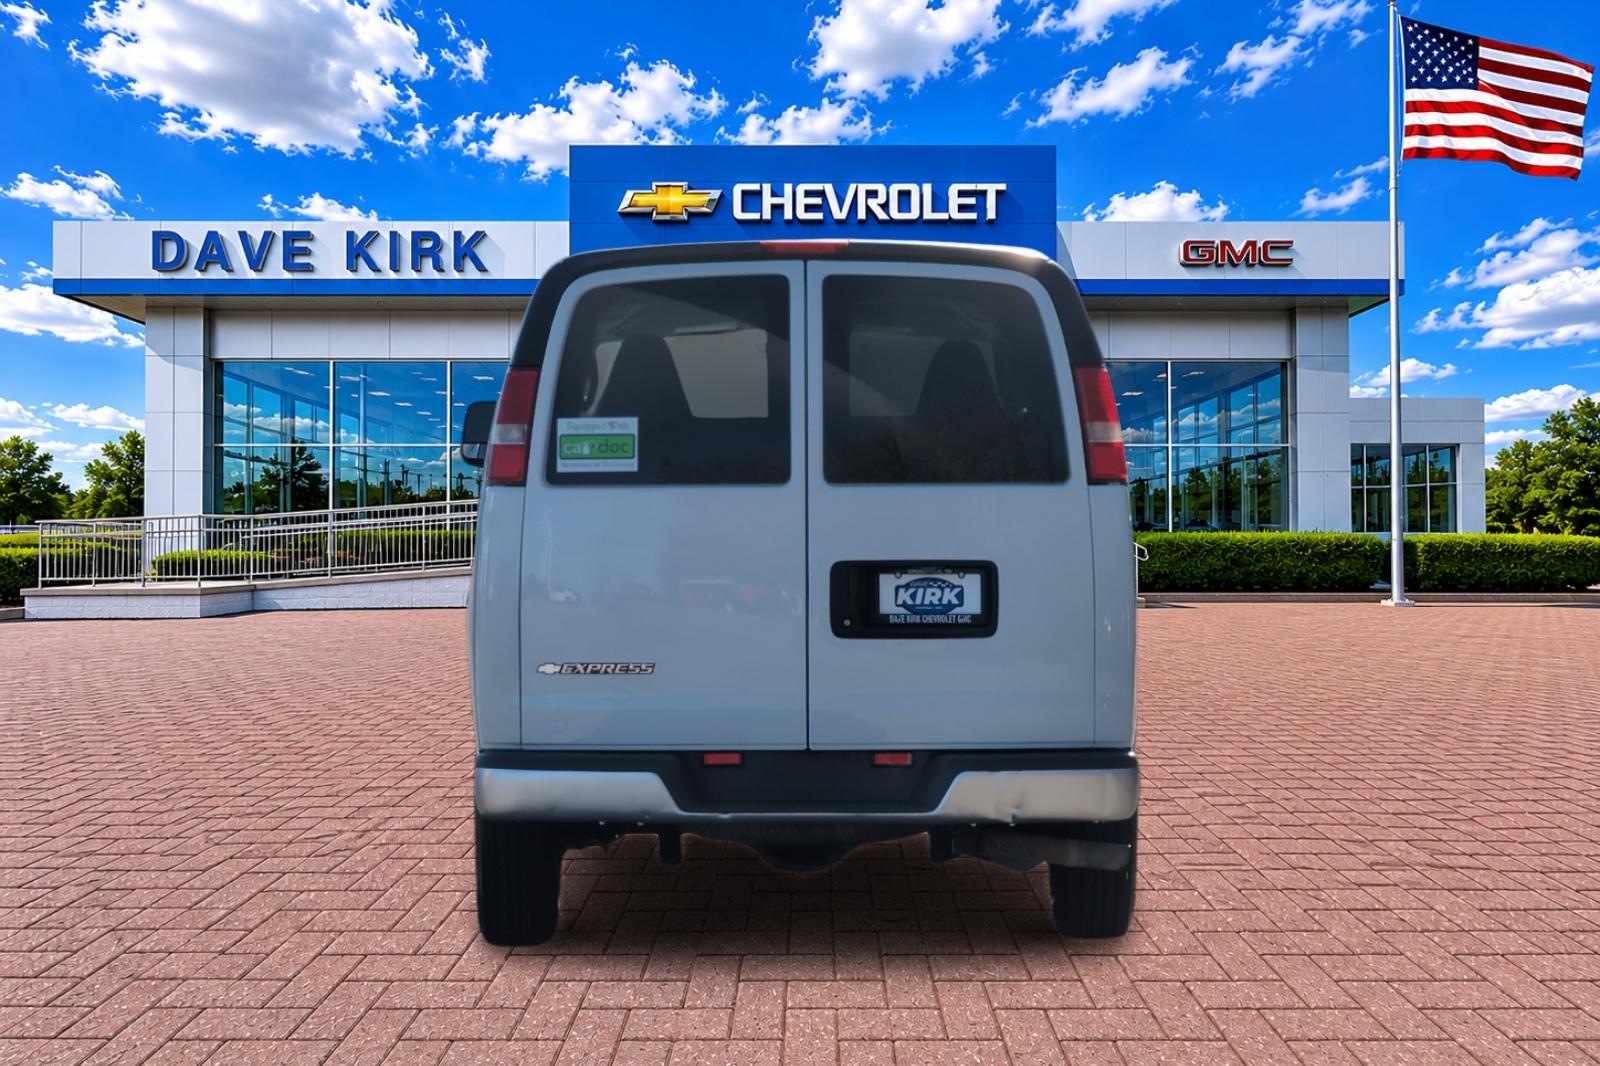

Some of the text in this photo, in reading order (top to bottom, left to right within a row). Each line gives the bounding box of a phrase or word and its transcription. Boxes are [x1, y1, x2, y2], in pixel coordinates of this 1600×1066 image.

[732, 183, 1007, 222] CHEVROLET
[151, 230, 489, 273] DAVE KIRK
[1180, 239, 1294, 267] GMC
[896, 587, 962, 605] KIRK
[889, 614, 972, 624] DAVE KIRK CHEVROLET GMC
[560, 663, 655, 674] EXPRESS
